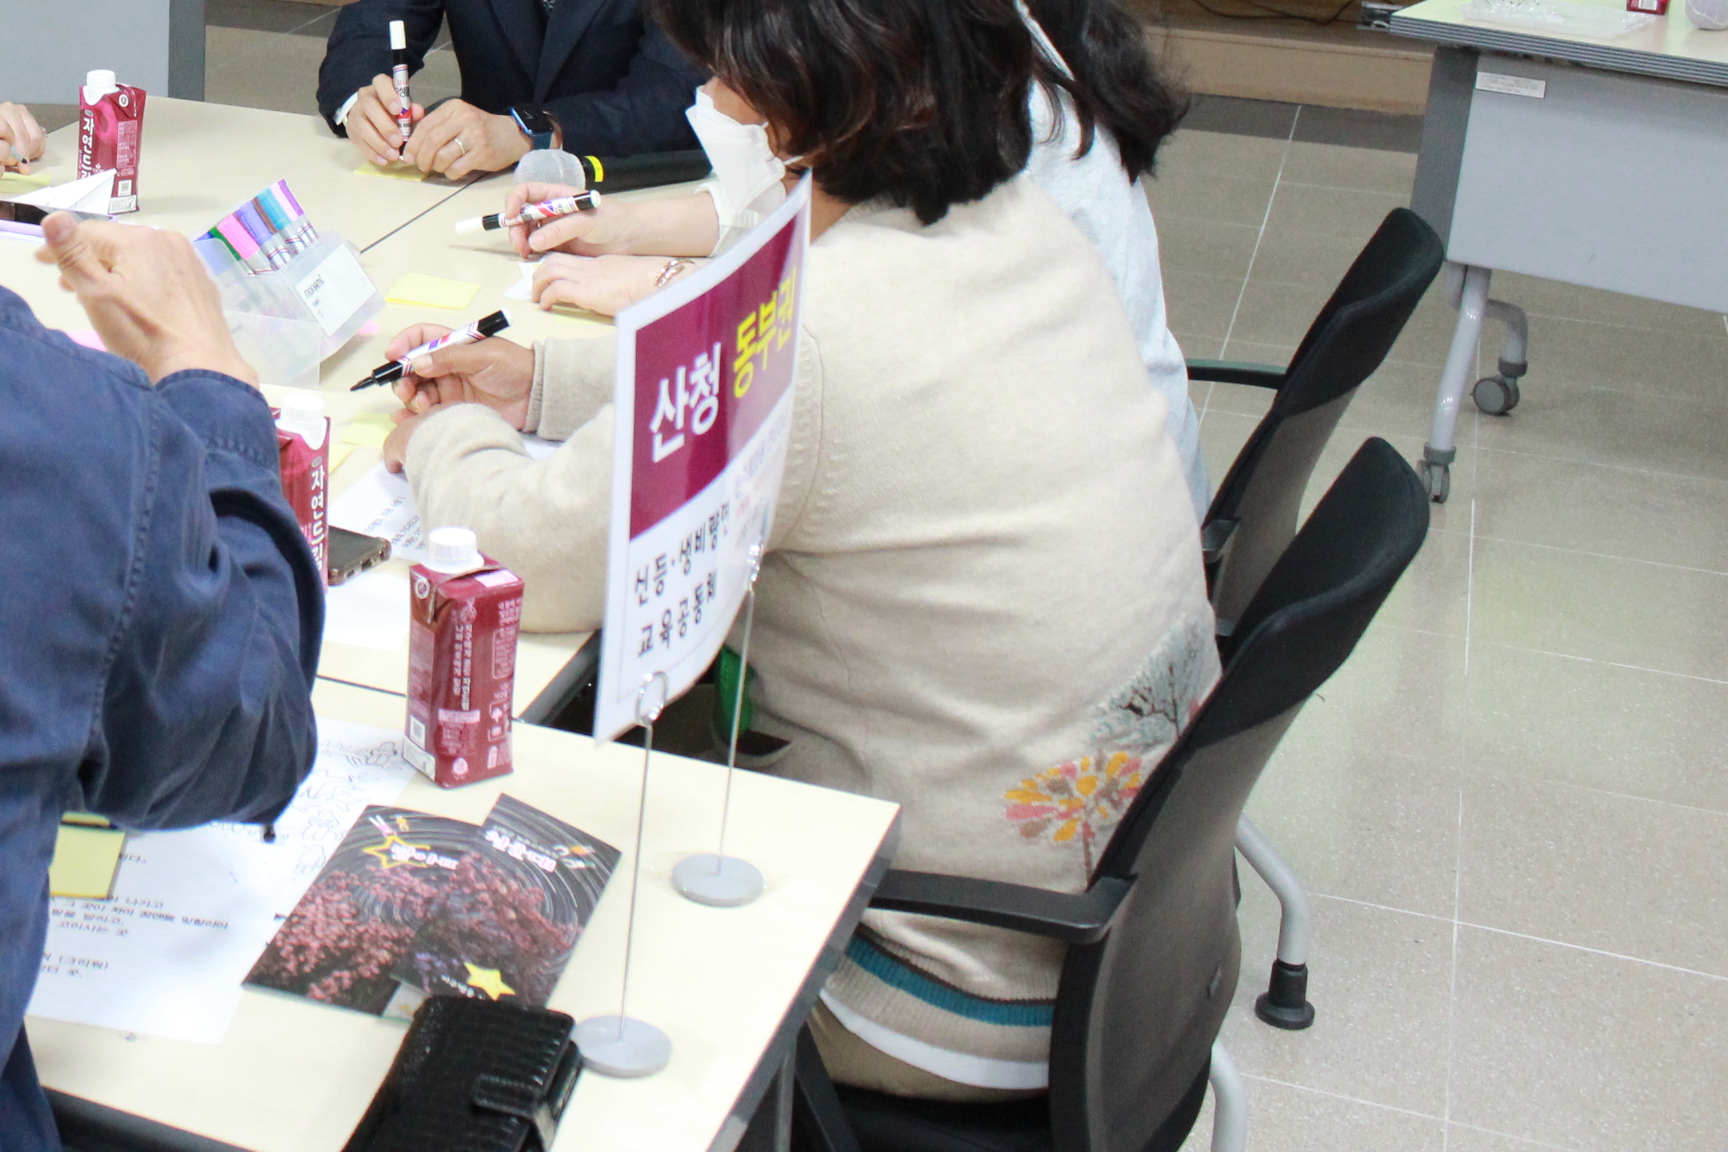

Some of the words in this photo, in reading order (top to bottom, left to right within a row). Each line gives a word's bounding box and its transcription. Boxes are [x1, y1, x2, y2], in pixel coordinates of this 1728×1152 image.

[648, 341, 722, 465] 산청
[732, 265, 798, 400] 동부권
[638, 567, 718, 659] 교육공동체
